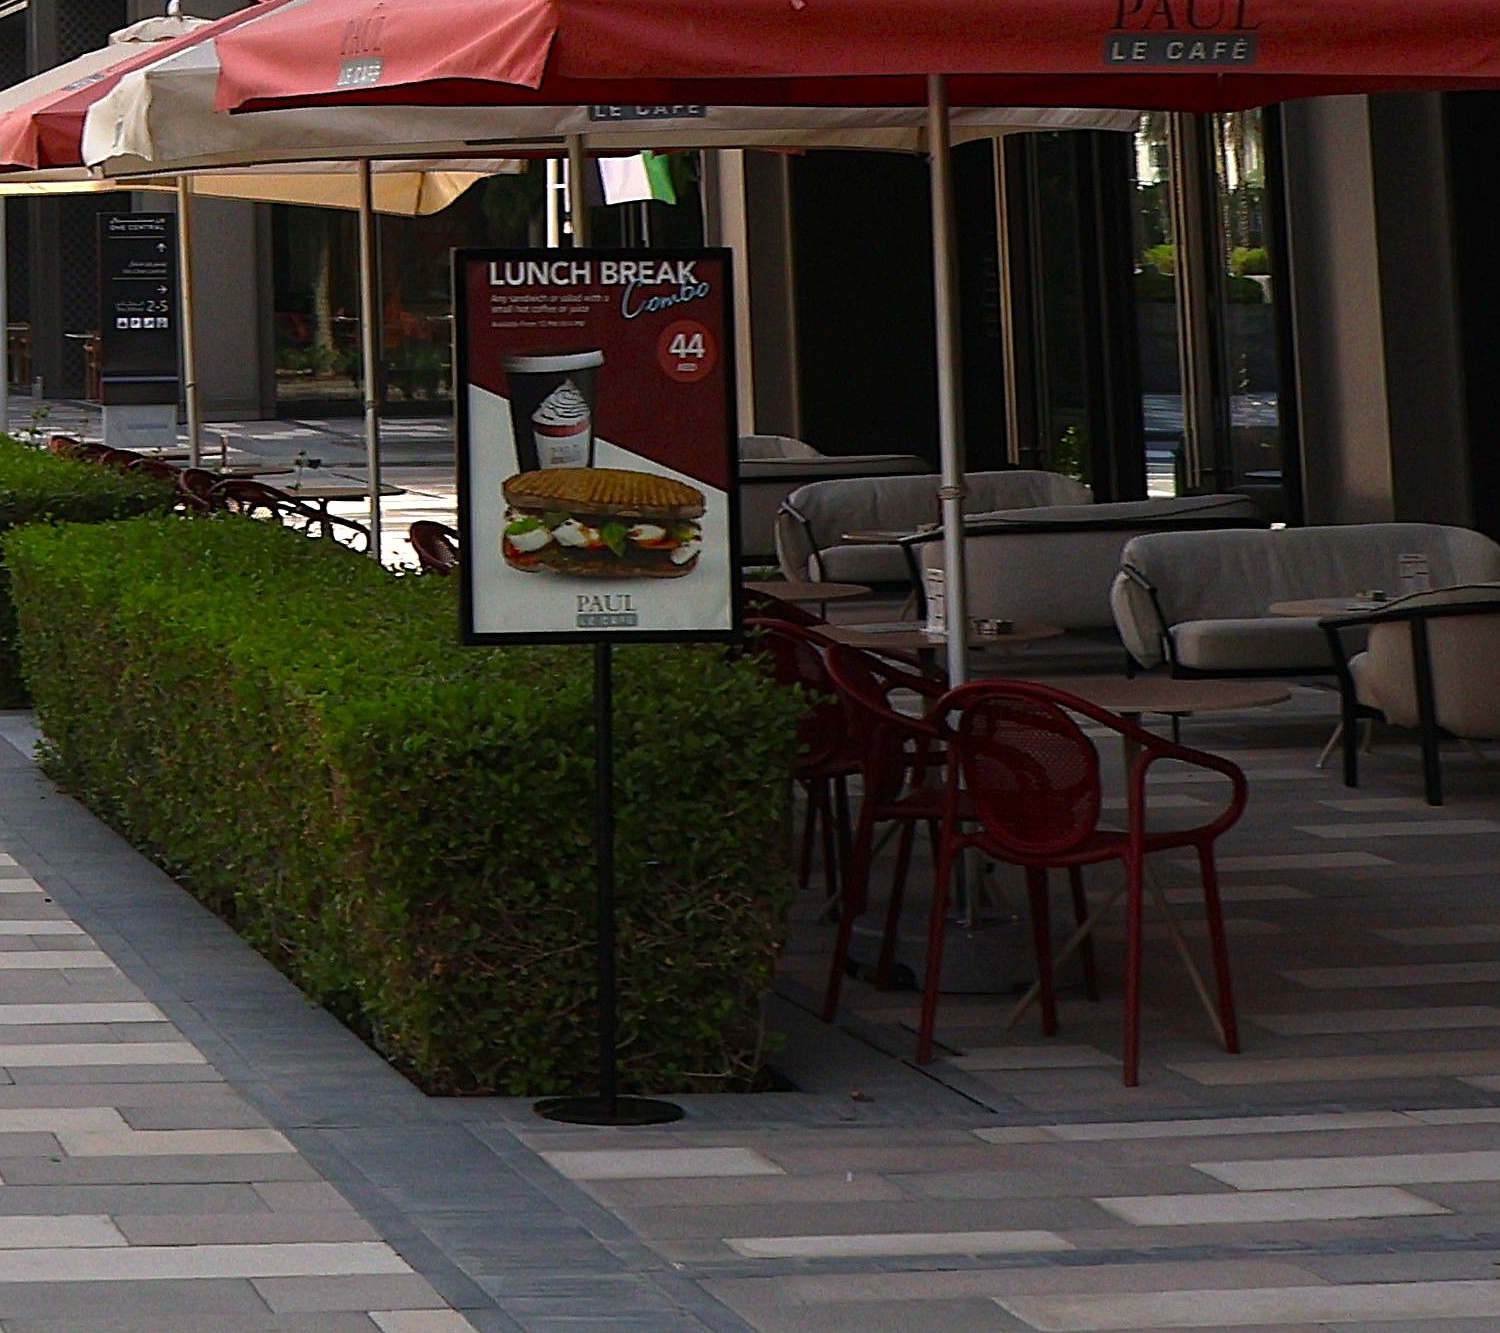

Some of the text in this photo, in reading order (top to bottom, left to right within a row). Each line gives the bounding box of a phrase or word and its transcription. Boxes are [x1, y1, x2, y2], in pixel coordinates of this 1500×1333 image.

[1111, 34, 1248, 61] LE CAFÉ
[489, 261, 699, 286] LUNCH BREAK
[620, 279, 711, 319] Combo
[668, 332, 706, 359] 44
[576, 593, 638, 613] PAUL
